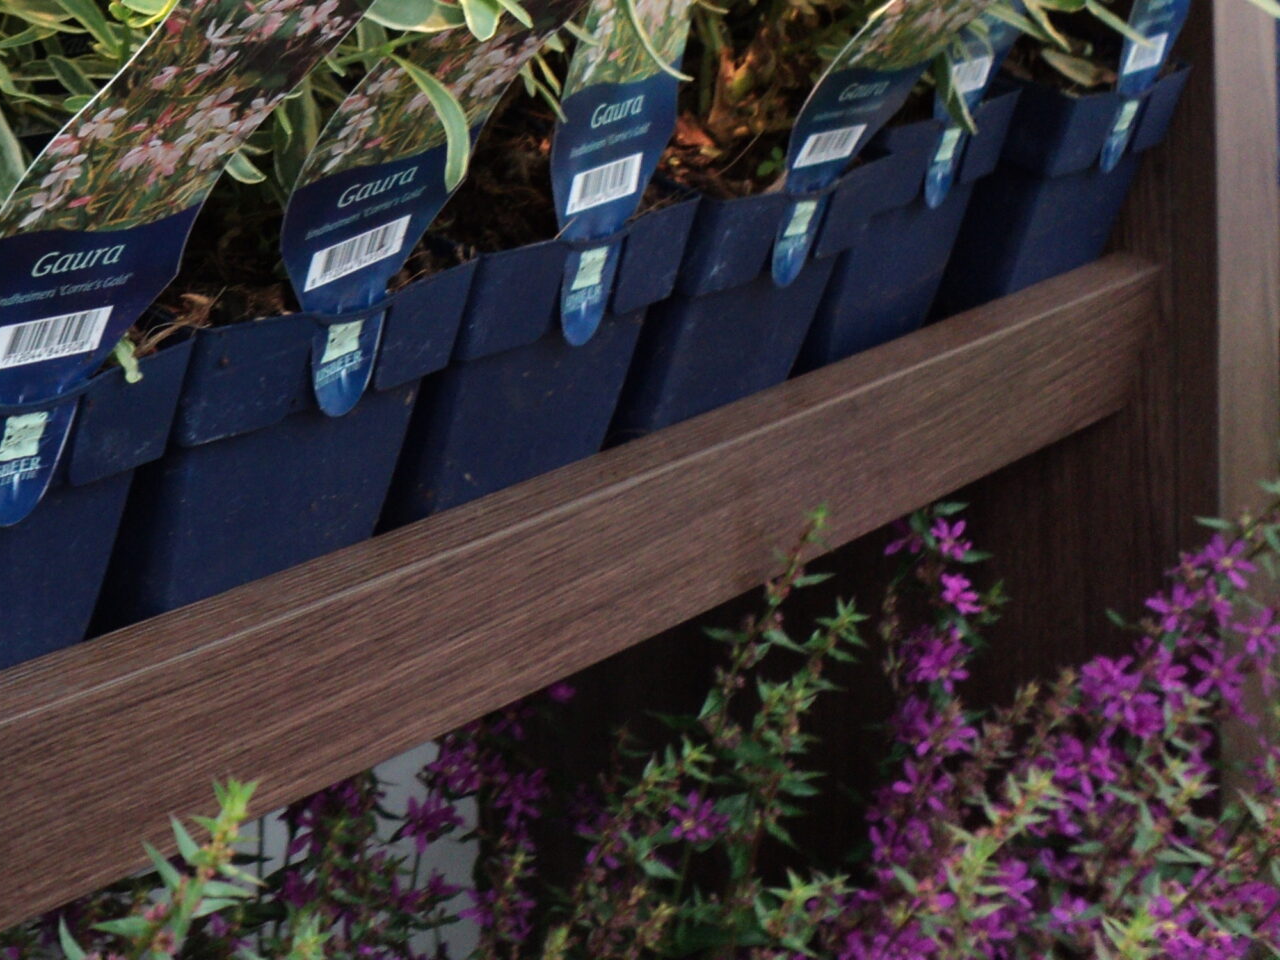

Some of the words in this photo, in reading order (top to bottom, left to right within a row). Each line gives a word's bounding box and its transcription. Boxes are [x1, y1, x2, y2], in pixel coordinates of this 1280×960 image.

[590, 94, 645, 129] Gaura
[337, 166, 419, 208] Gaura
[31, 243, 127, 278] Gaura
